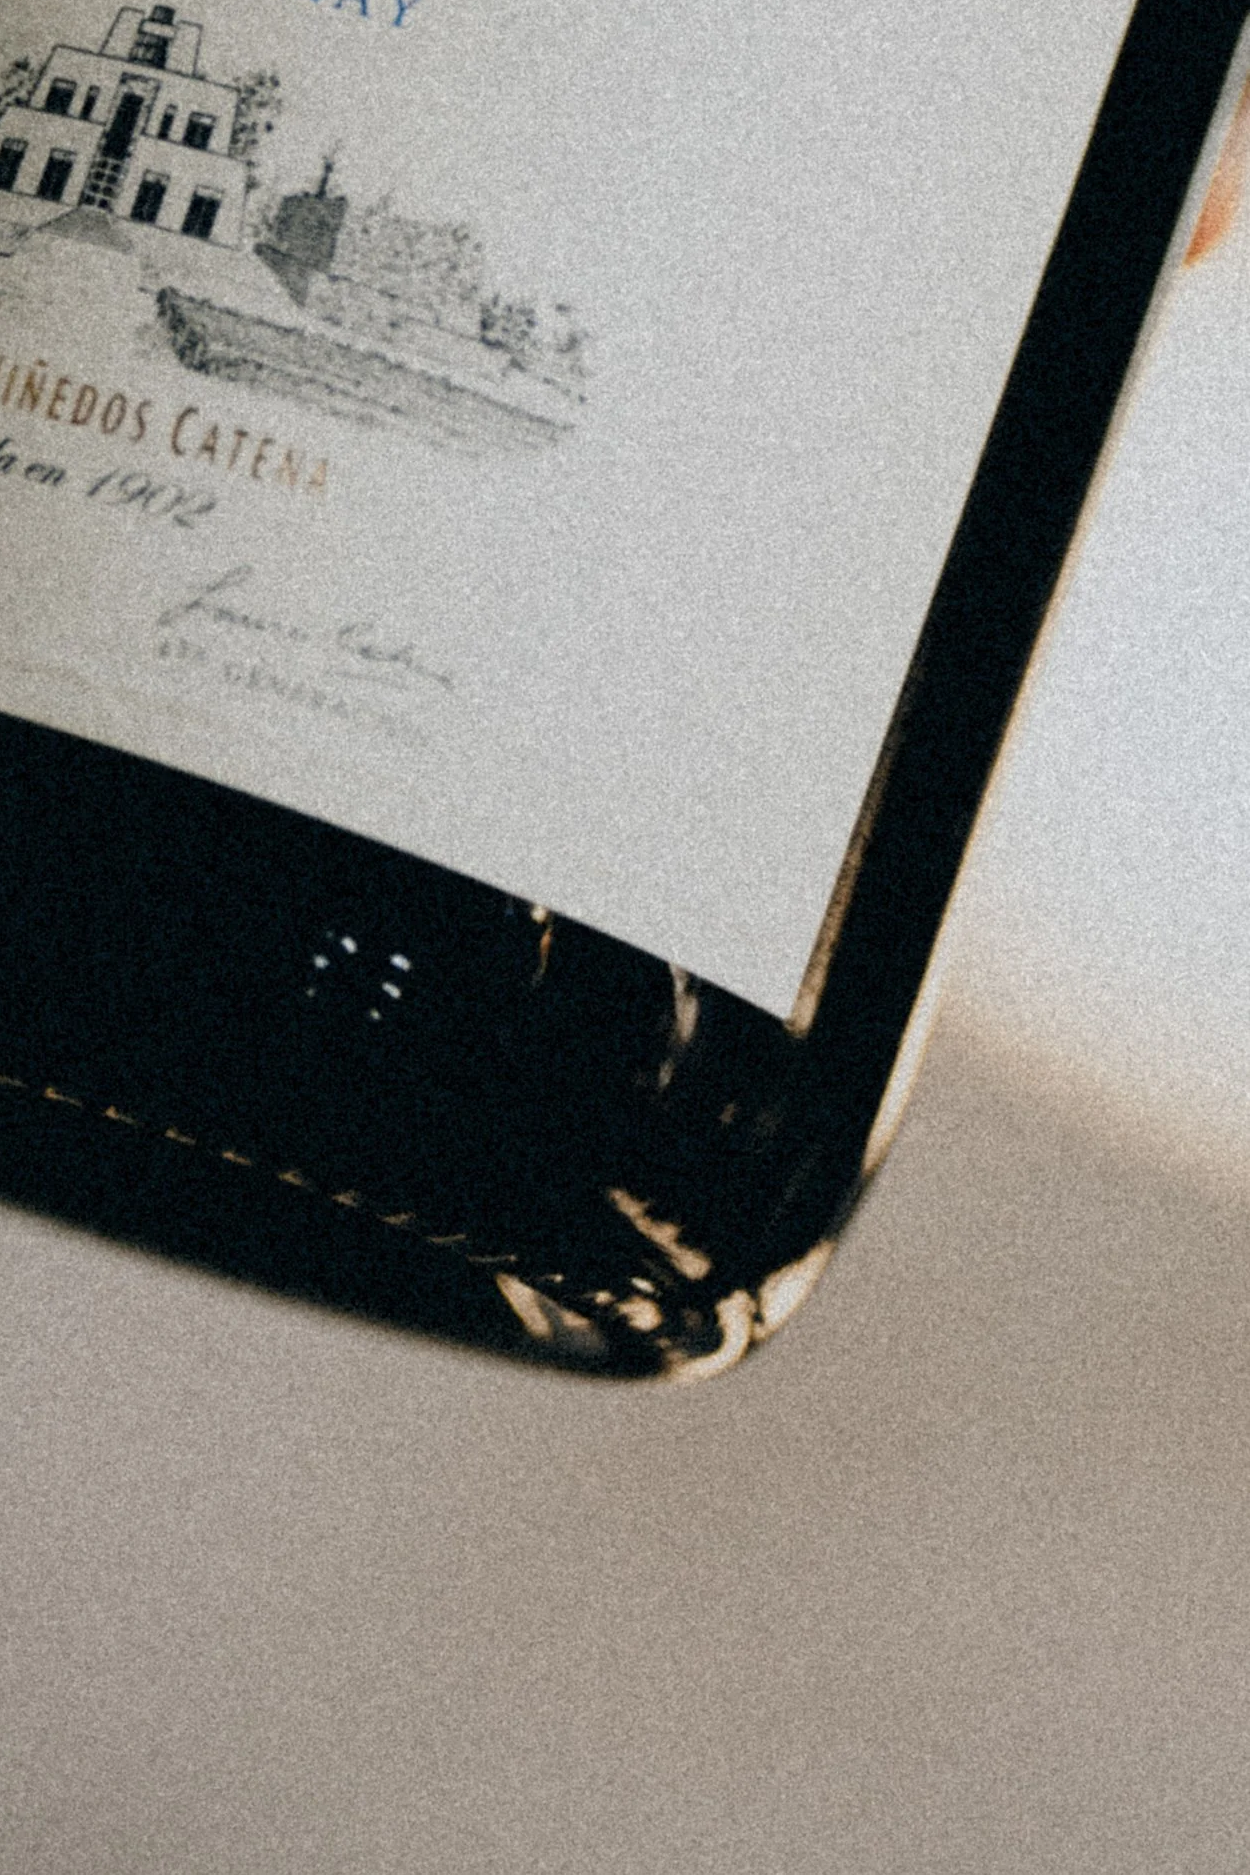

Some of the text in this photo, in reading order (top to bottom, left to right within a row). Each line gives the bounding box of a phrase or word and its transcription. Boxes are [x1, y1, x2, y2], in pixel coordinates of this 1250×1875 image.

[170, 406, 332, 496] CATENA
[23, 462, 67, 488] en
[84, 467, 218, 529] 1902
